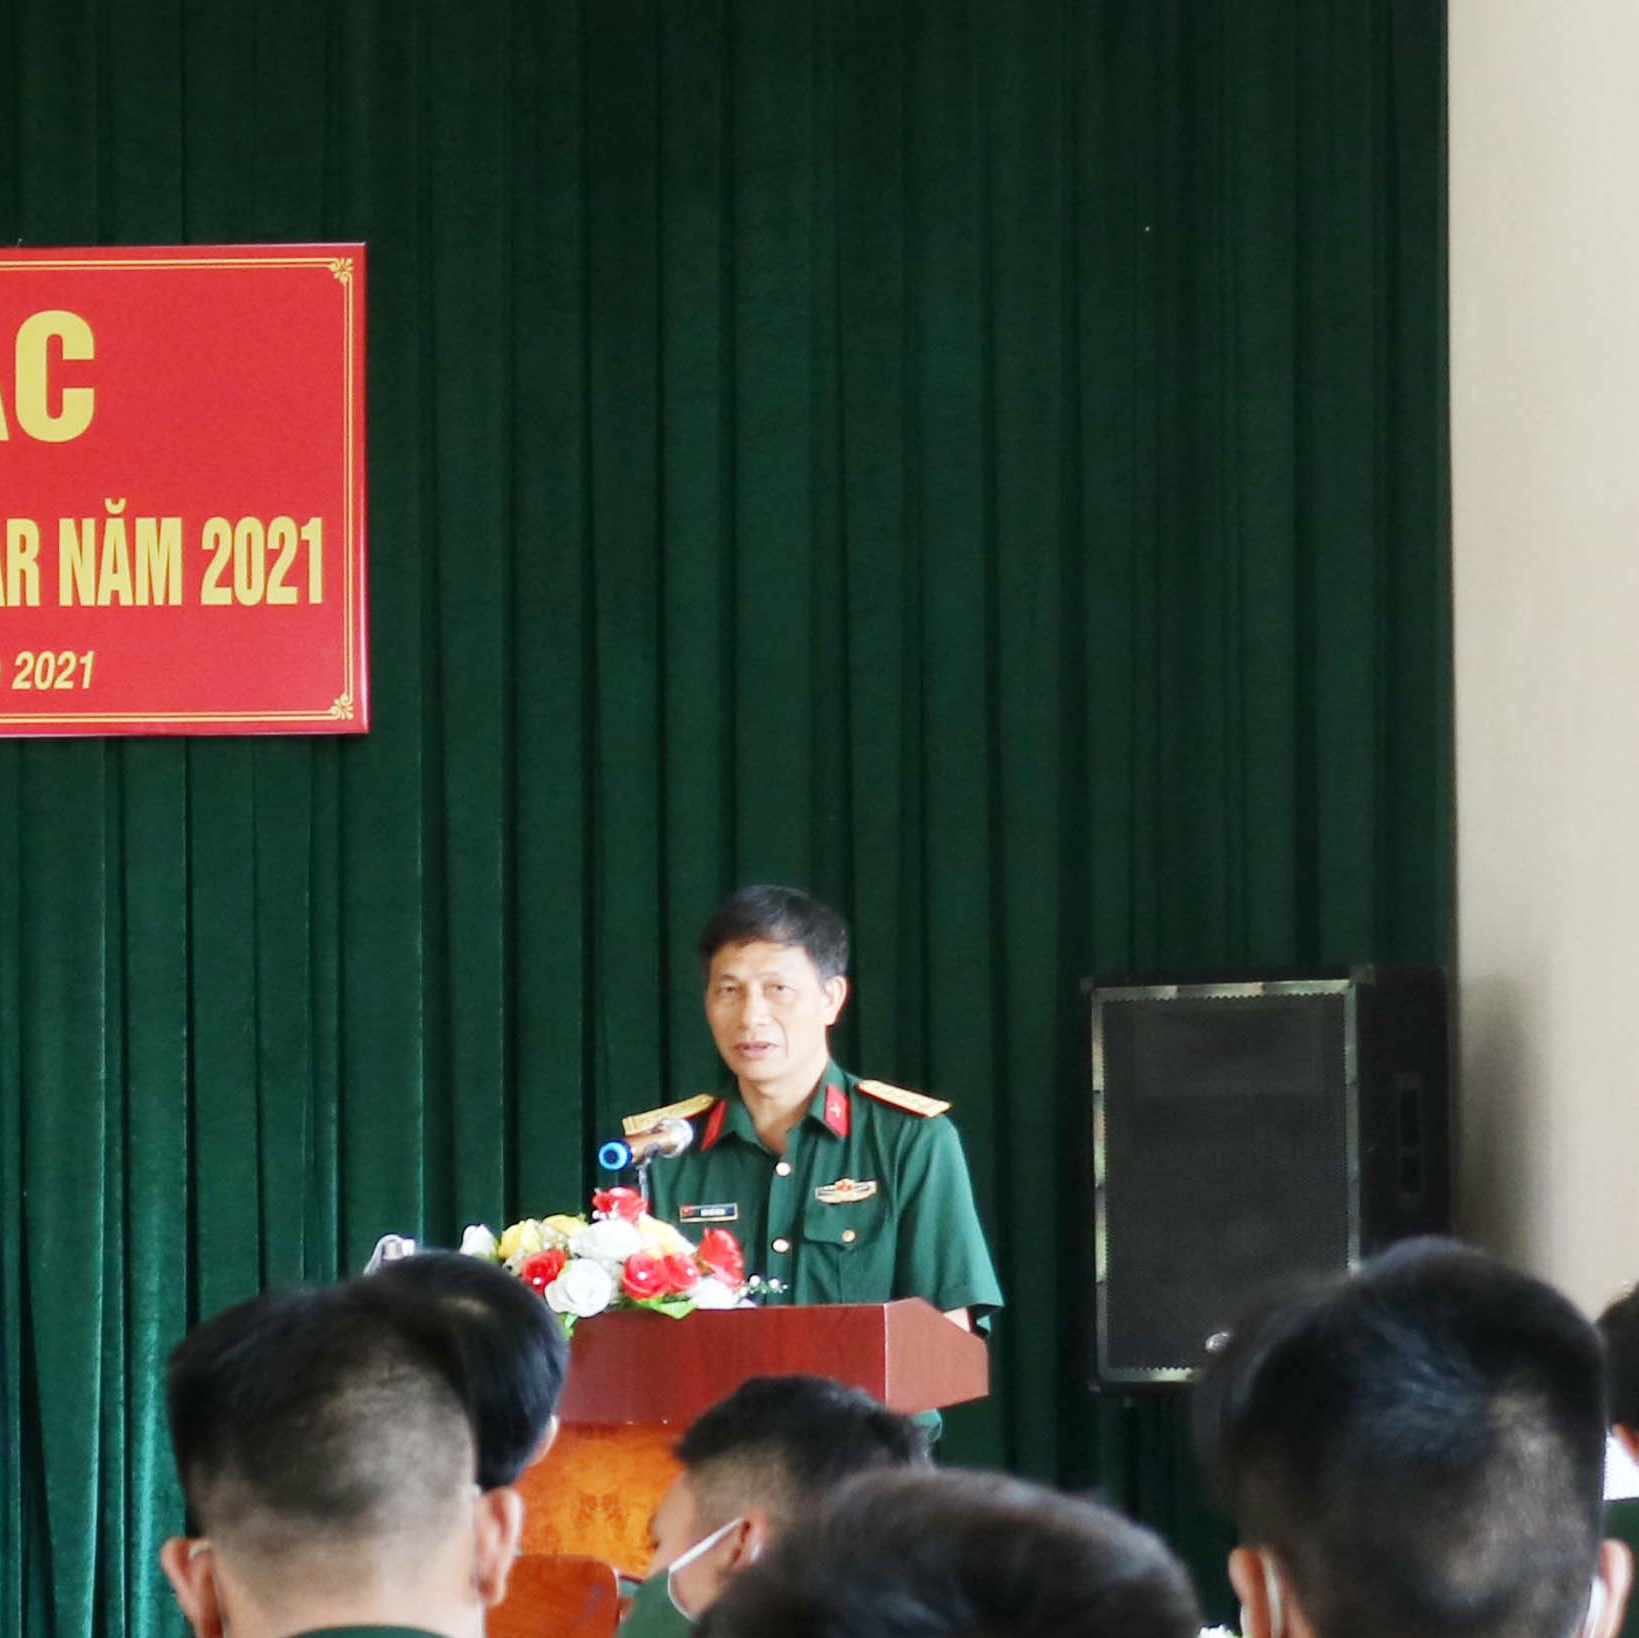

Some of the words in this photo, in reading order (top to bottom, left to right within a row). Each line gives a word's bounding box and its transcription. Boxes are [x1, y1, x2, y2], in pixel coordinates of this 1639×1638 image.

[58, 497, 184, 607] NĂM
[200, 515, 325, 607] 2021
[11, 649, 96, 691] 2021
